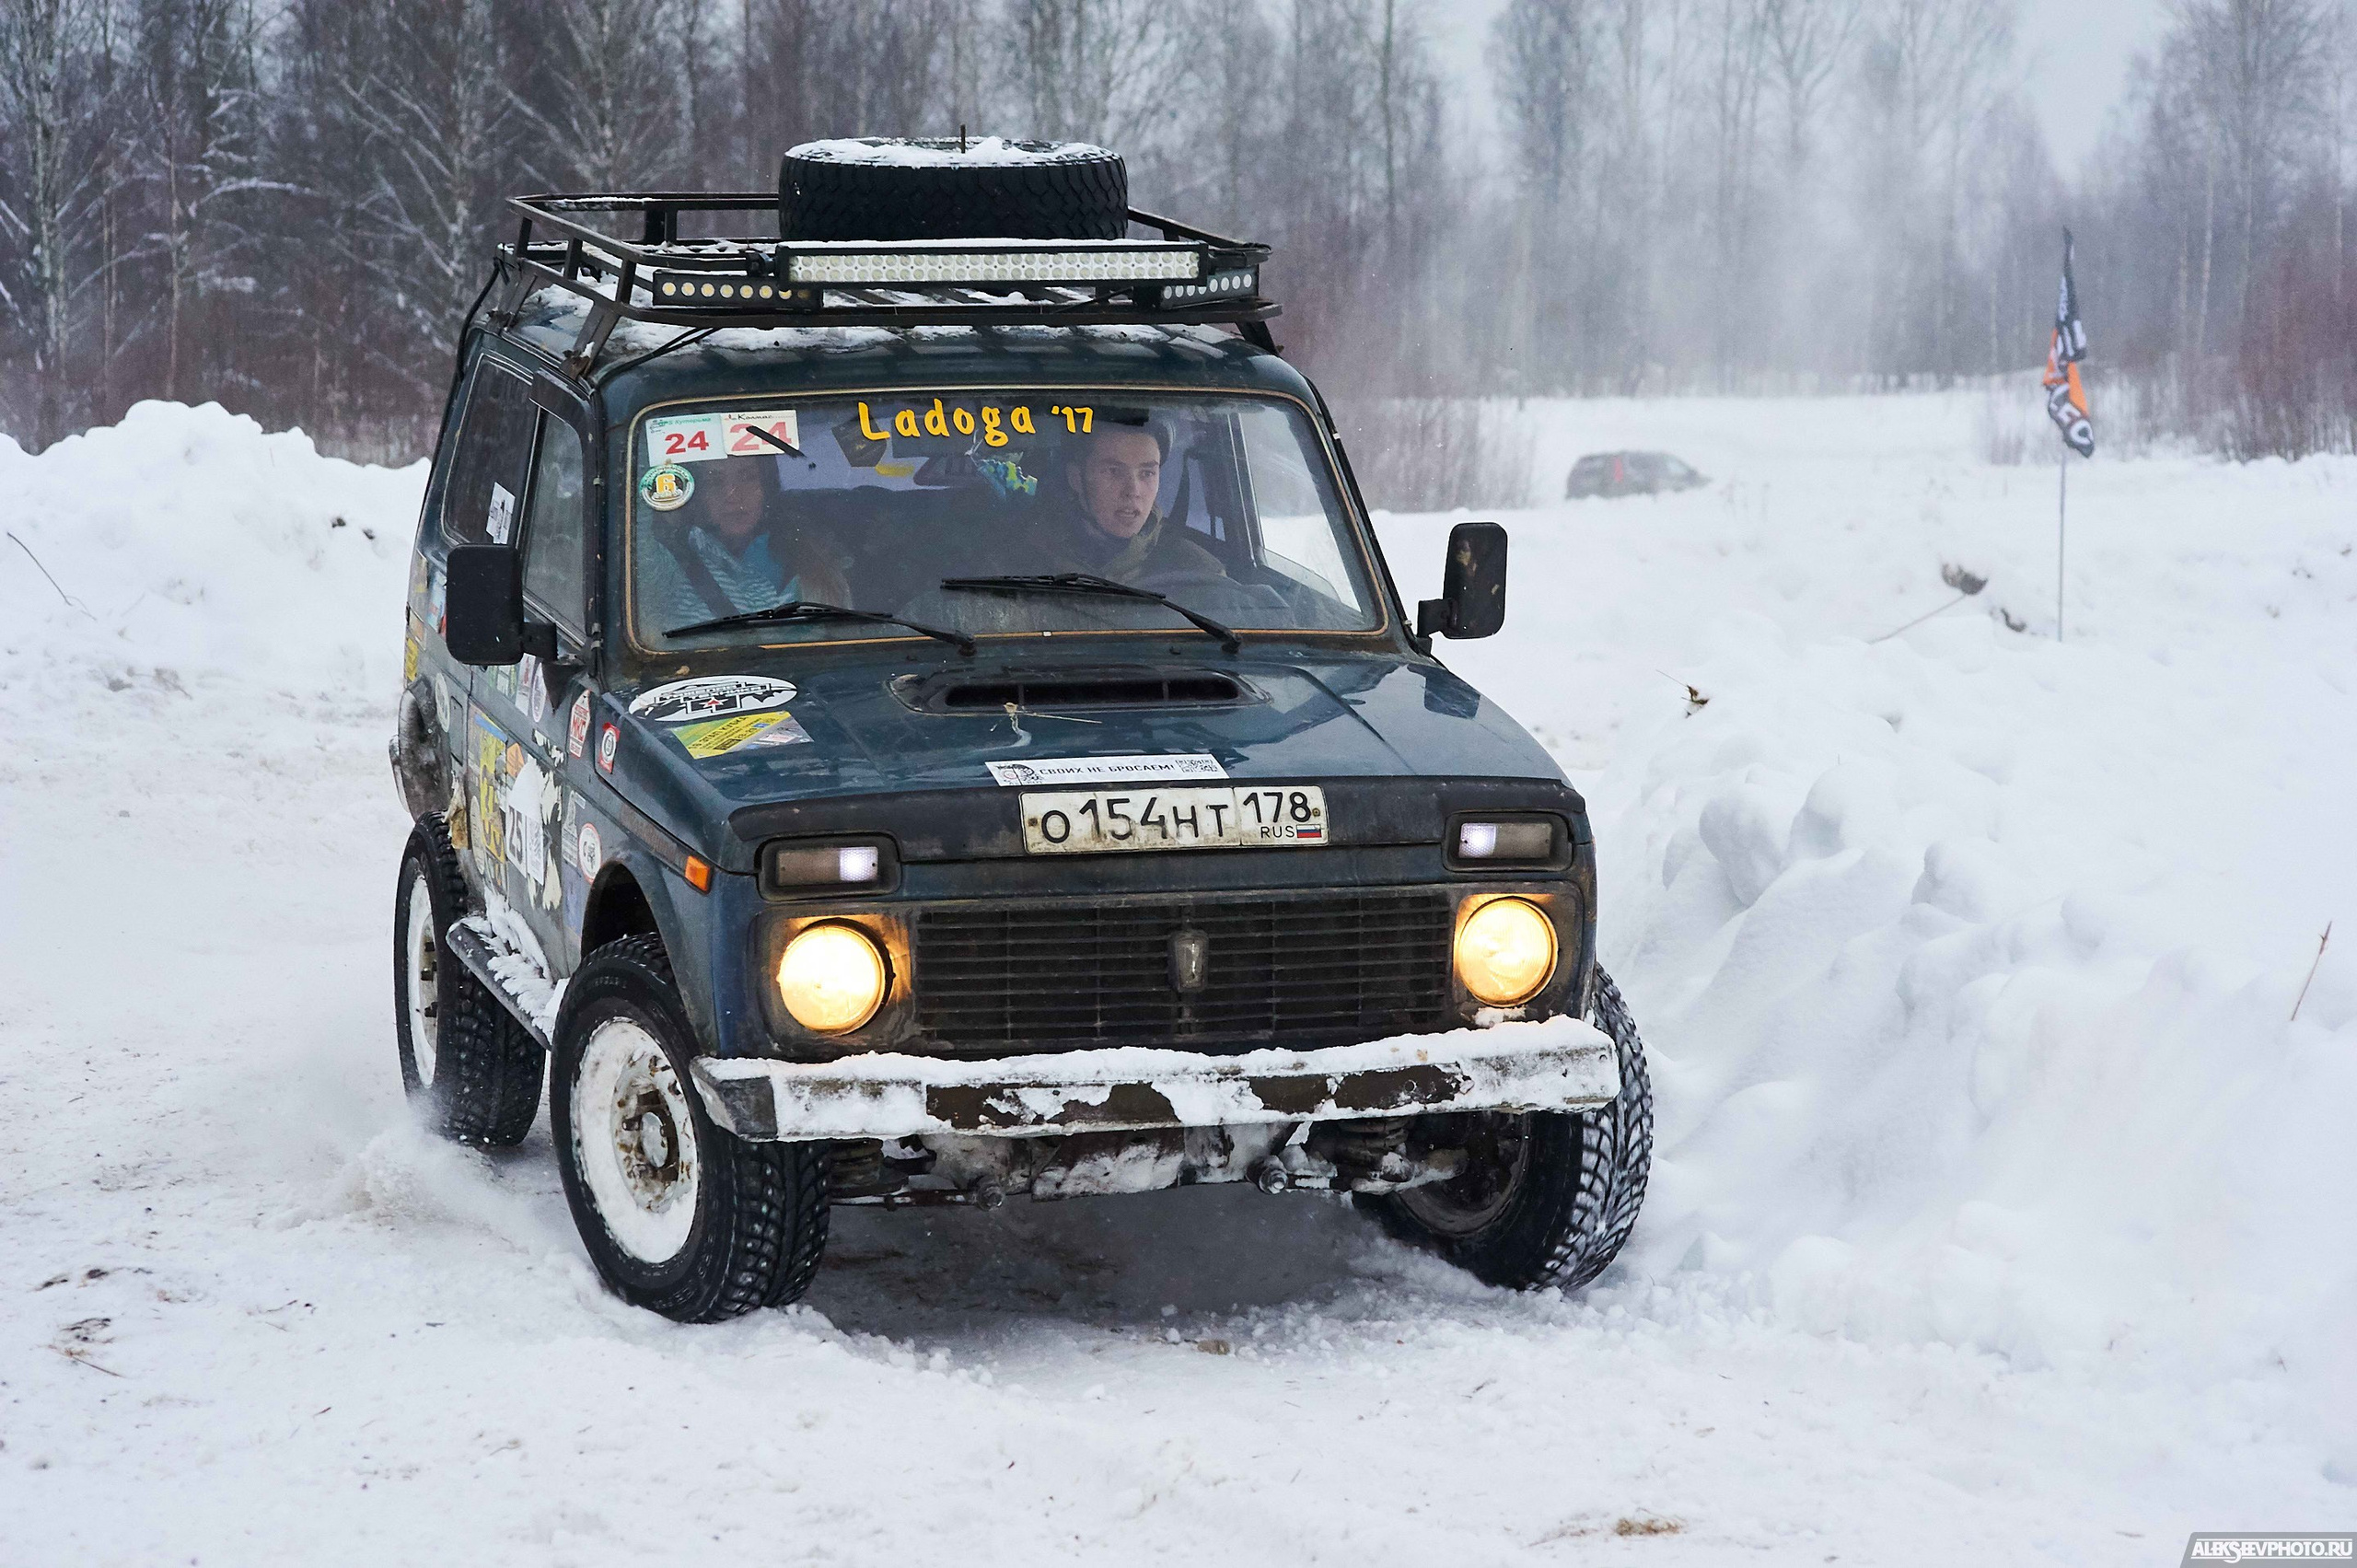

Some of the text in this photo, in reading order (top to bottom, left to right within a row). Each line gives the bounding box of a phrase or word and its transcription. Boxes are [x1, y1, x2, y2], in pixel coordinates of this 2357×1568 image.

[730, 421, 793, 452] 24
[857, 398, 1094, 447] Ladoga '17
[664, 430, 710, 455] 24
[1039, 767, 1084, 776] СВОИХ
[1109, 764, 1175, 773] БРОСАЕМ!
[1242, 792, 1312, 824] 178
[1260, 825, 1295, 839] RUS
